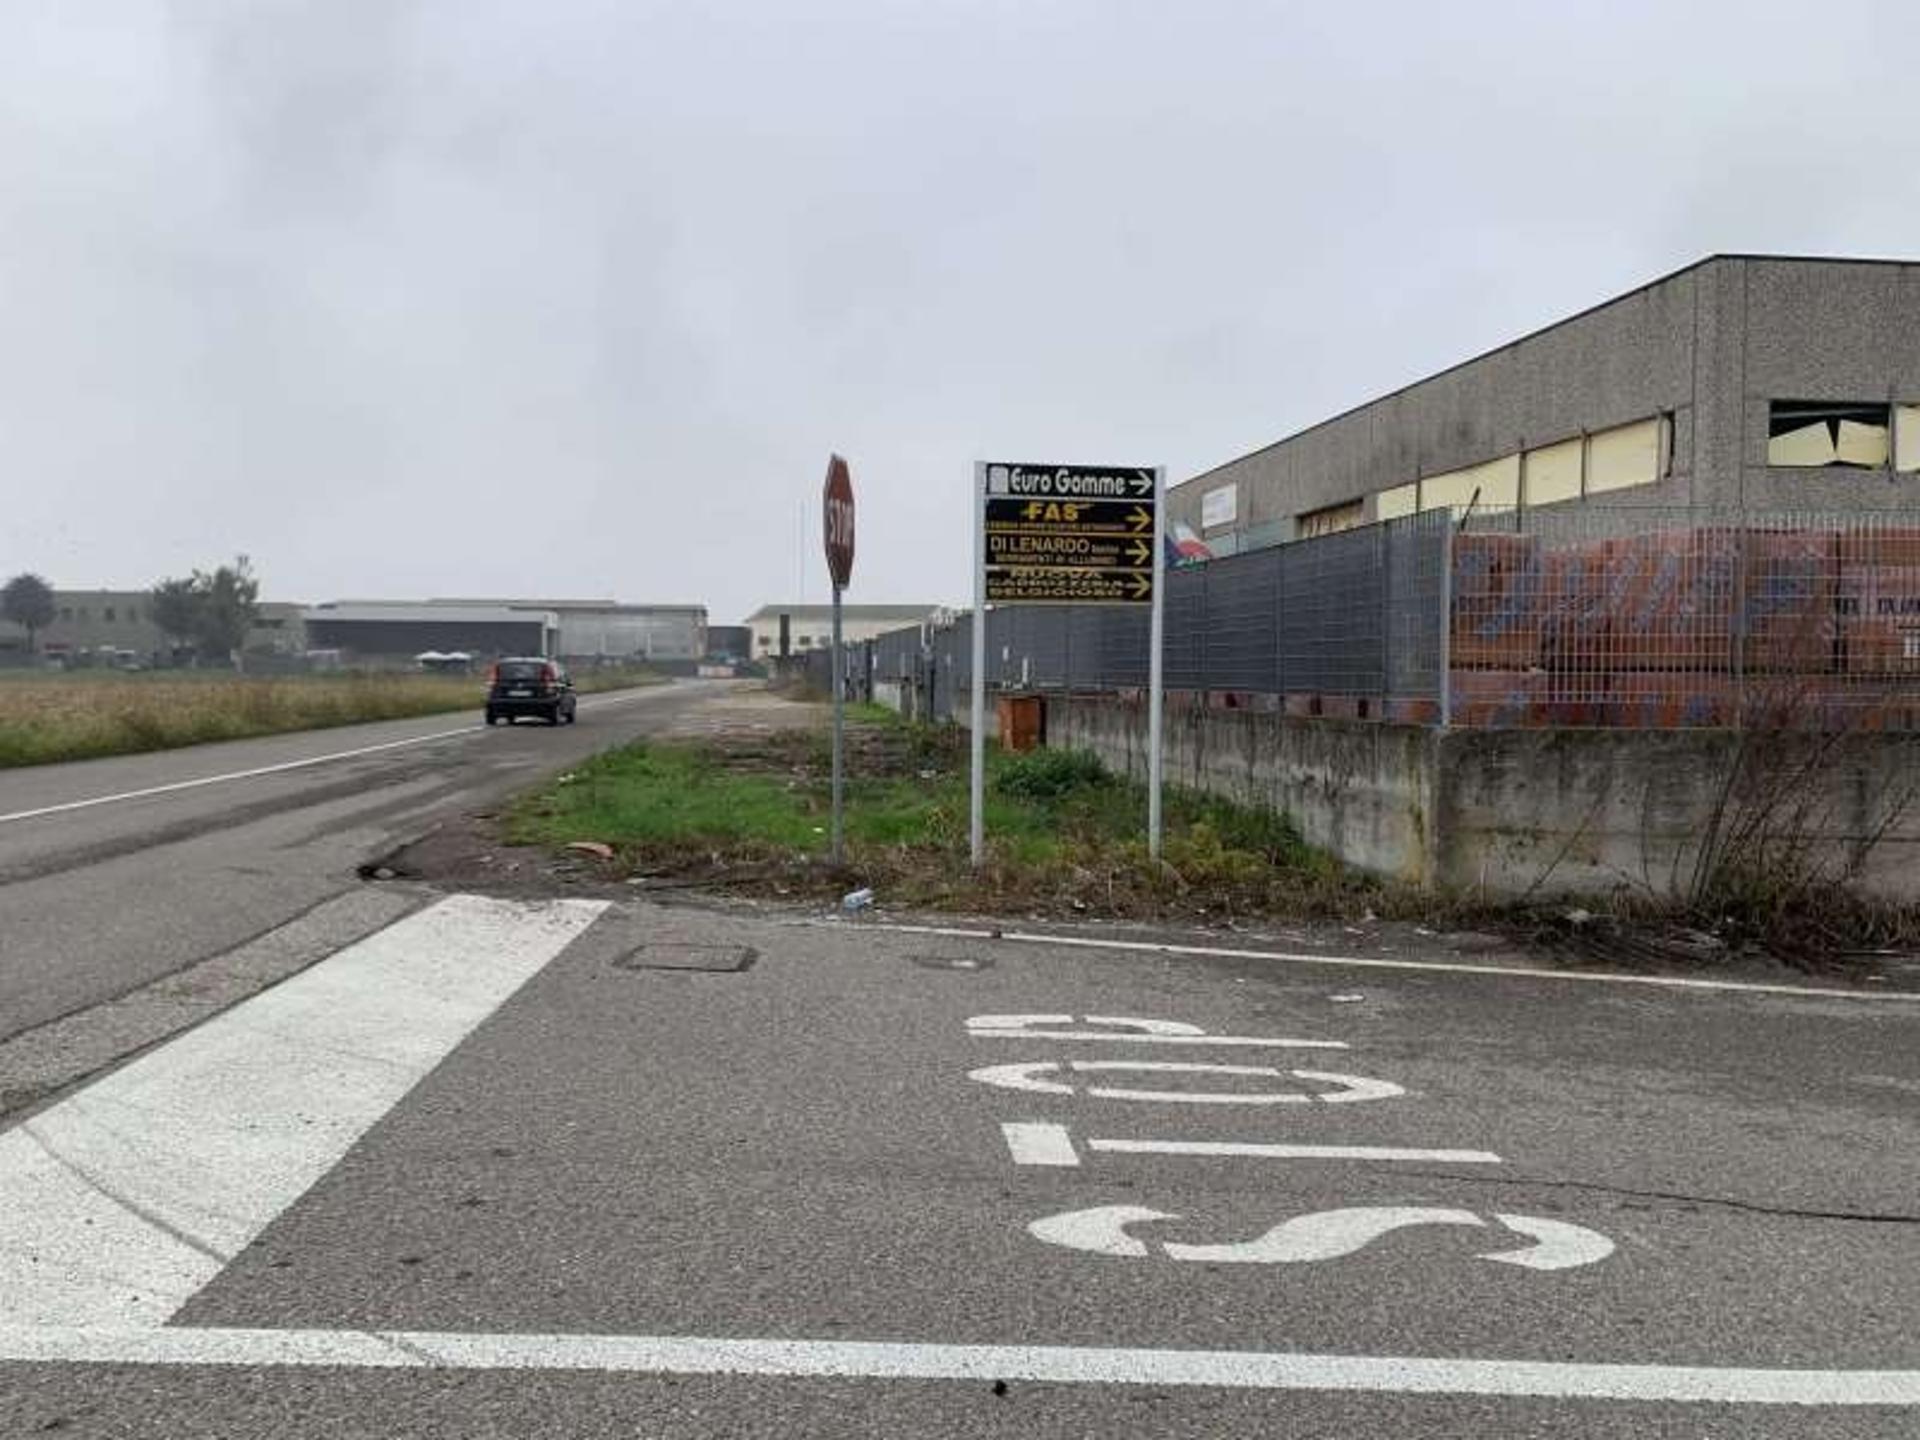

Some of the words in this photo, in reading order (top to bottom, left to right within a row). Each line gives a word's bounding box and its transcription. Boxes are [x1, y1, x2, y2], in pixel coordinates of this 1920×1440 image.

[1010, 467, 1052, 492] Euro
[1055, 468, 1126, 495] Gomme
[829, 499, 853, 546] STOP
[1027, 502, 1079, 521] FAS
[991, 536, 1006, 551] DI
[1010, 537, 1090, 554] LENARDO
[964, 1013, 1616, 1270] STOP
